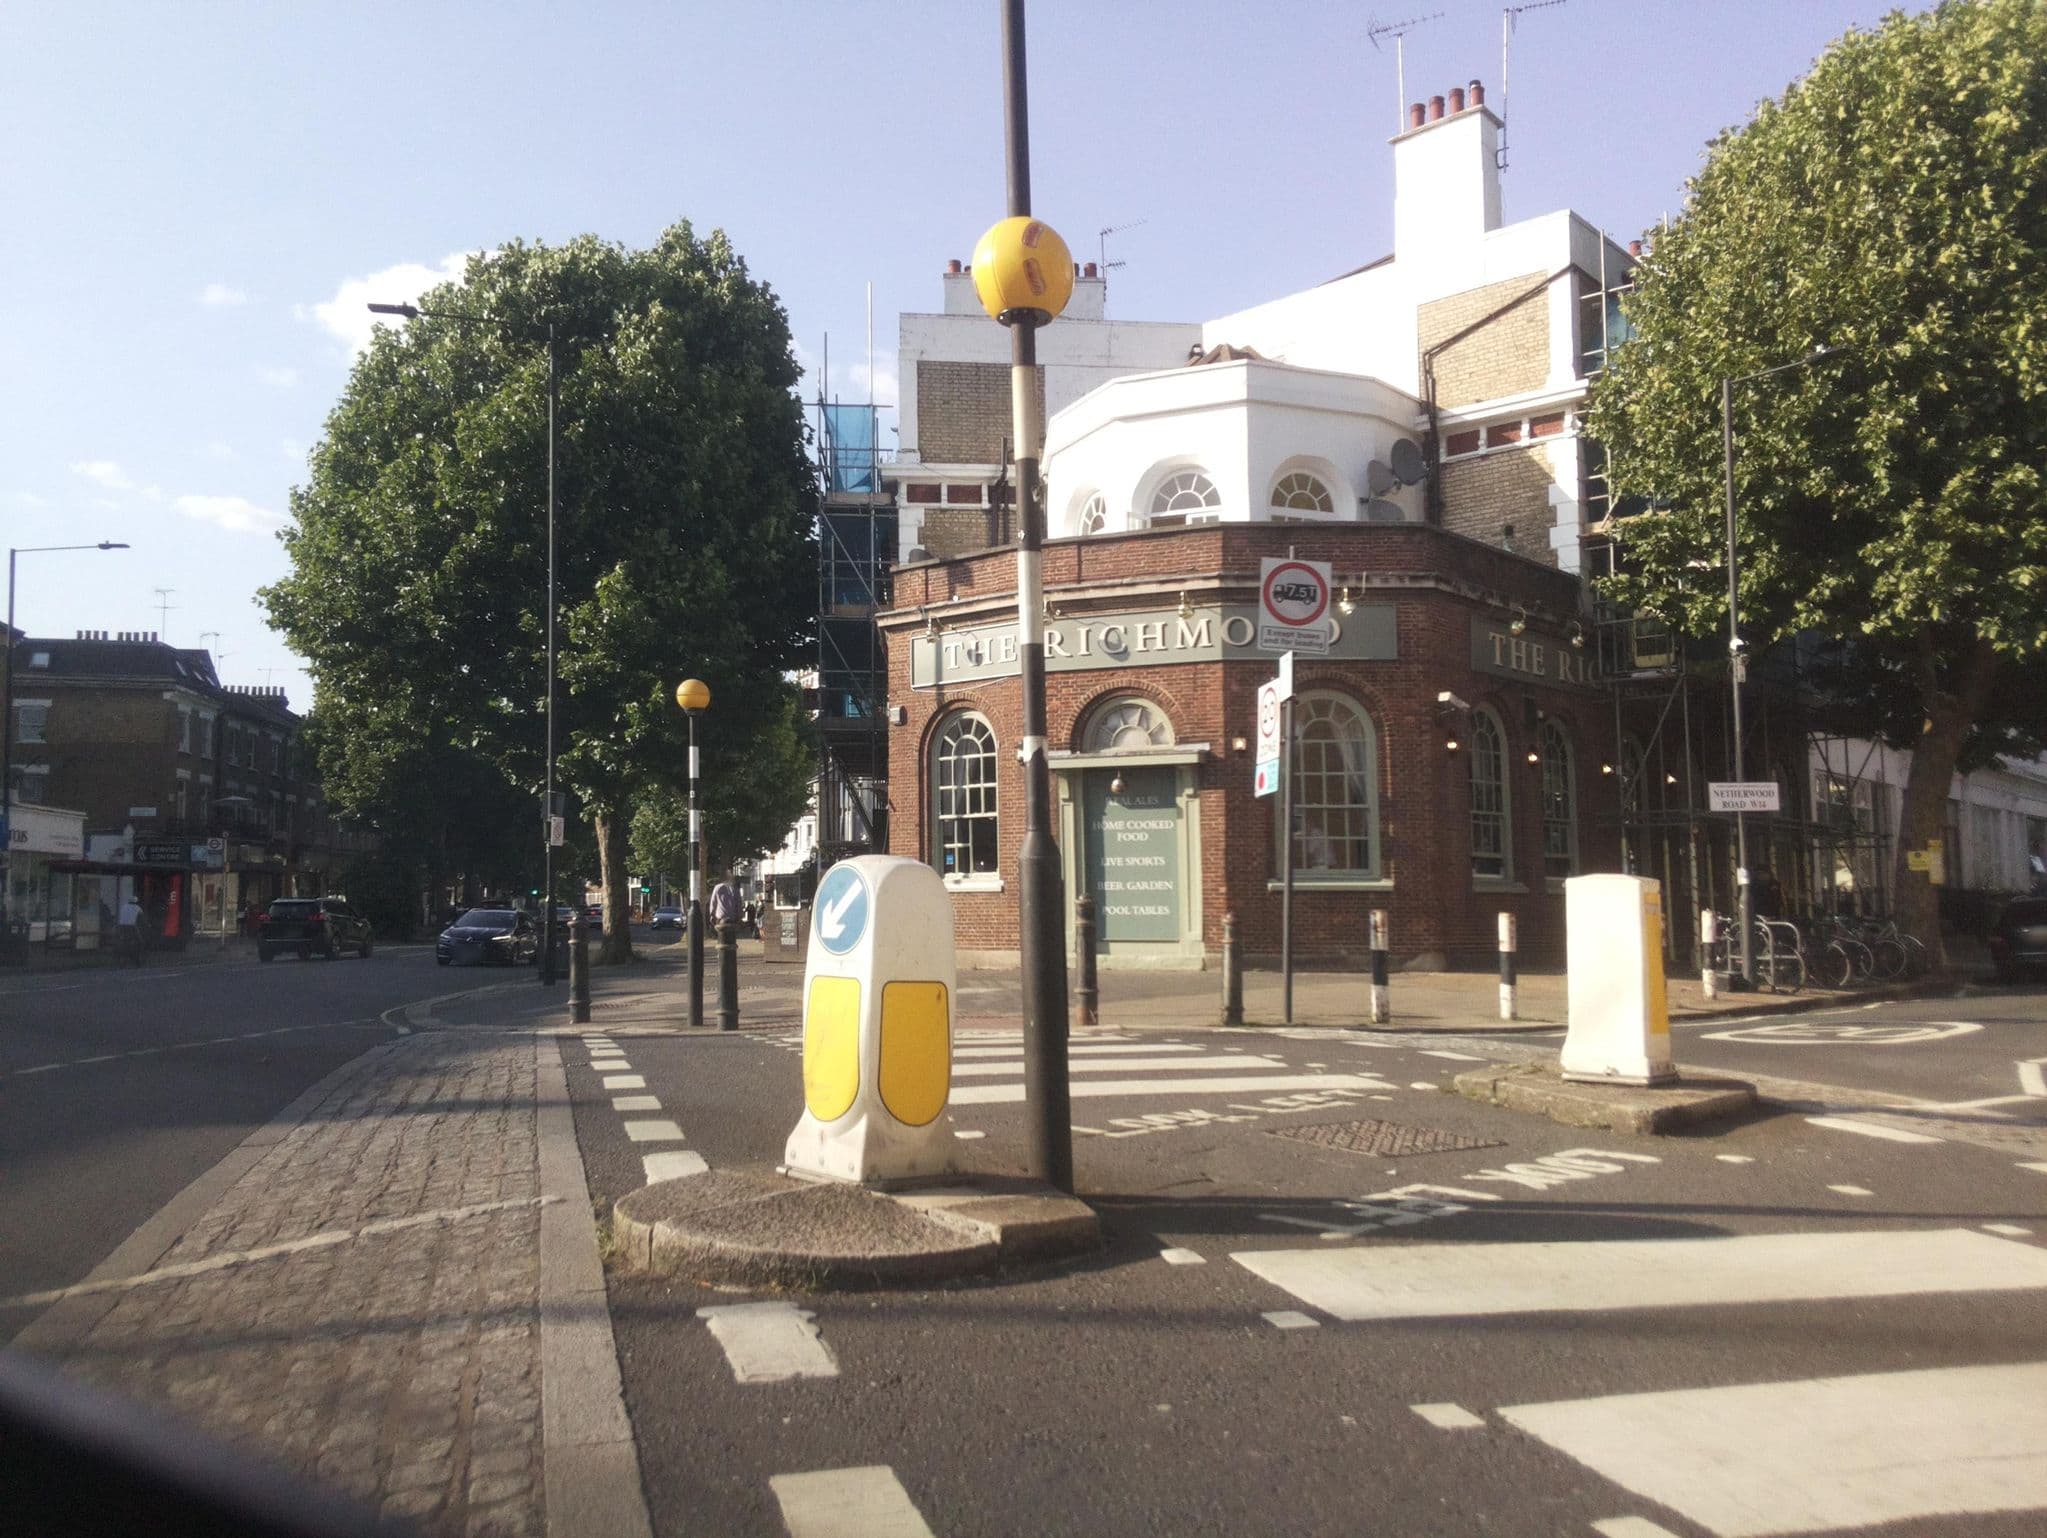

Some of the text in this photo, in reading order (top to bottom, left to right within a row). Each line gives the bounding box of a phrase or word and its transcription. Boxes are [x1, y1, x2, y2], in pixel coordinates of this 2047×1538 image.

[944, 616, 1341, 671] THE RICHMO
[1488, 631, 1546, 677] THE
[1713, 789, 1775, 799] NETHERWOOD
[1105, 796, 1160, 806] REAL ALES
[1722, 800, 1767, 809] ROAD W14
[1093, 820, 1174, 831] HOME COOKED
[1117, 832, 1149, 842] FOOD
[1101, 856, 1166, 867] LIVE SPORTS
[1097, 881, 1174, 891] BEER GARDEN
[1102, 905, 1171, 916] POOL TABLES
